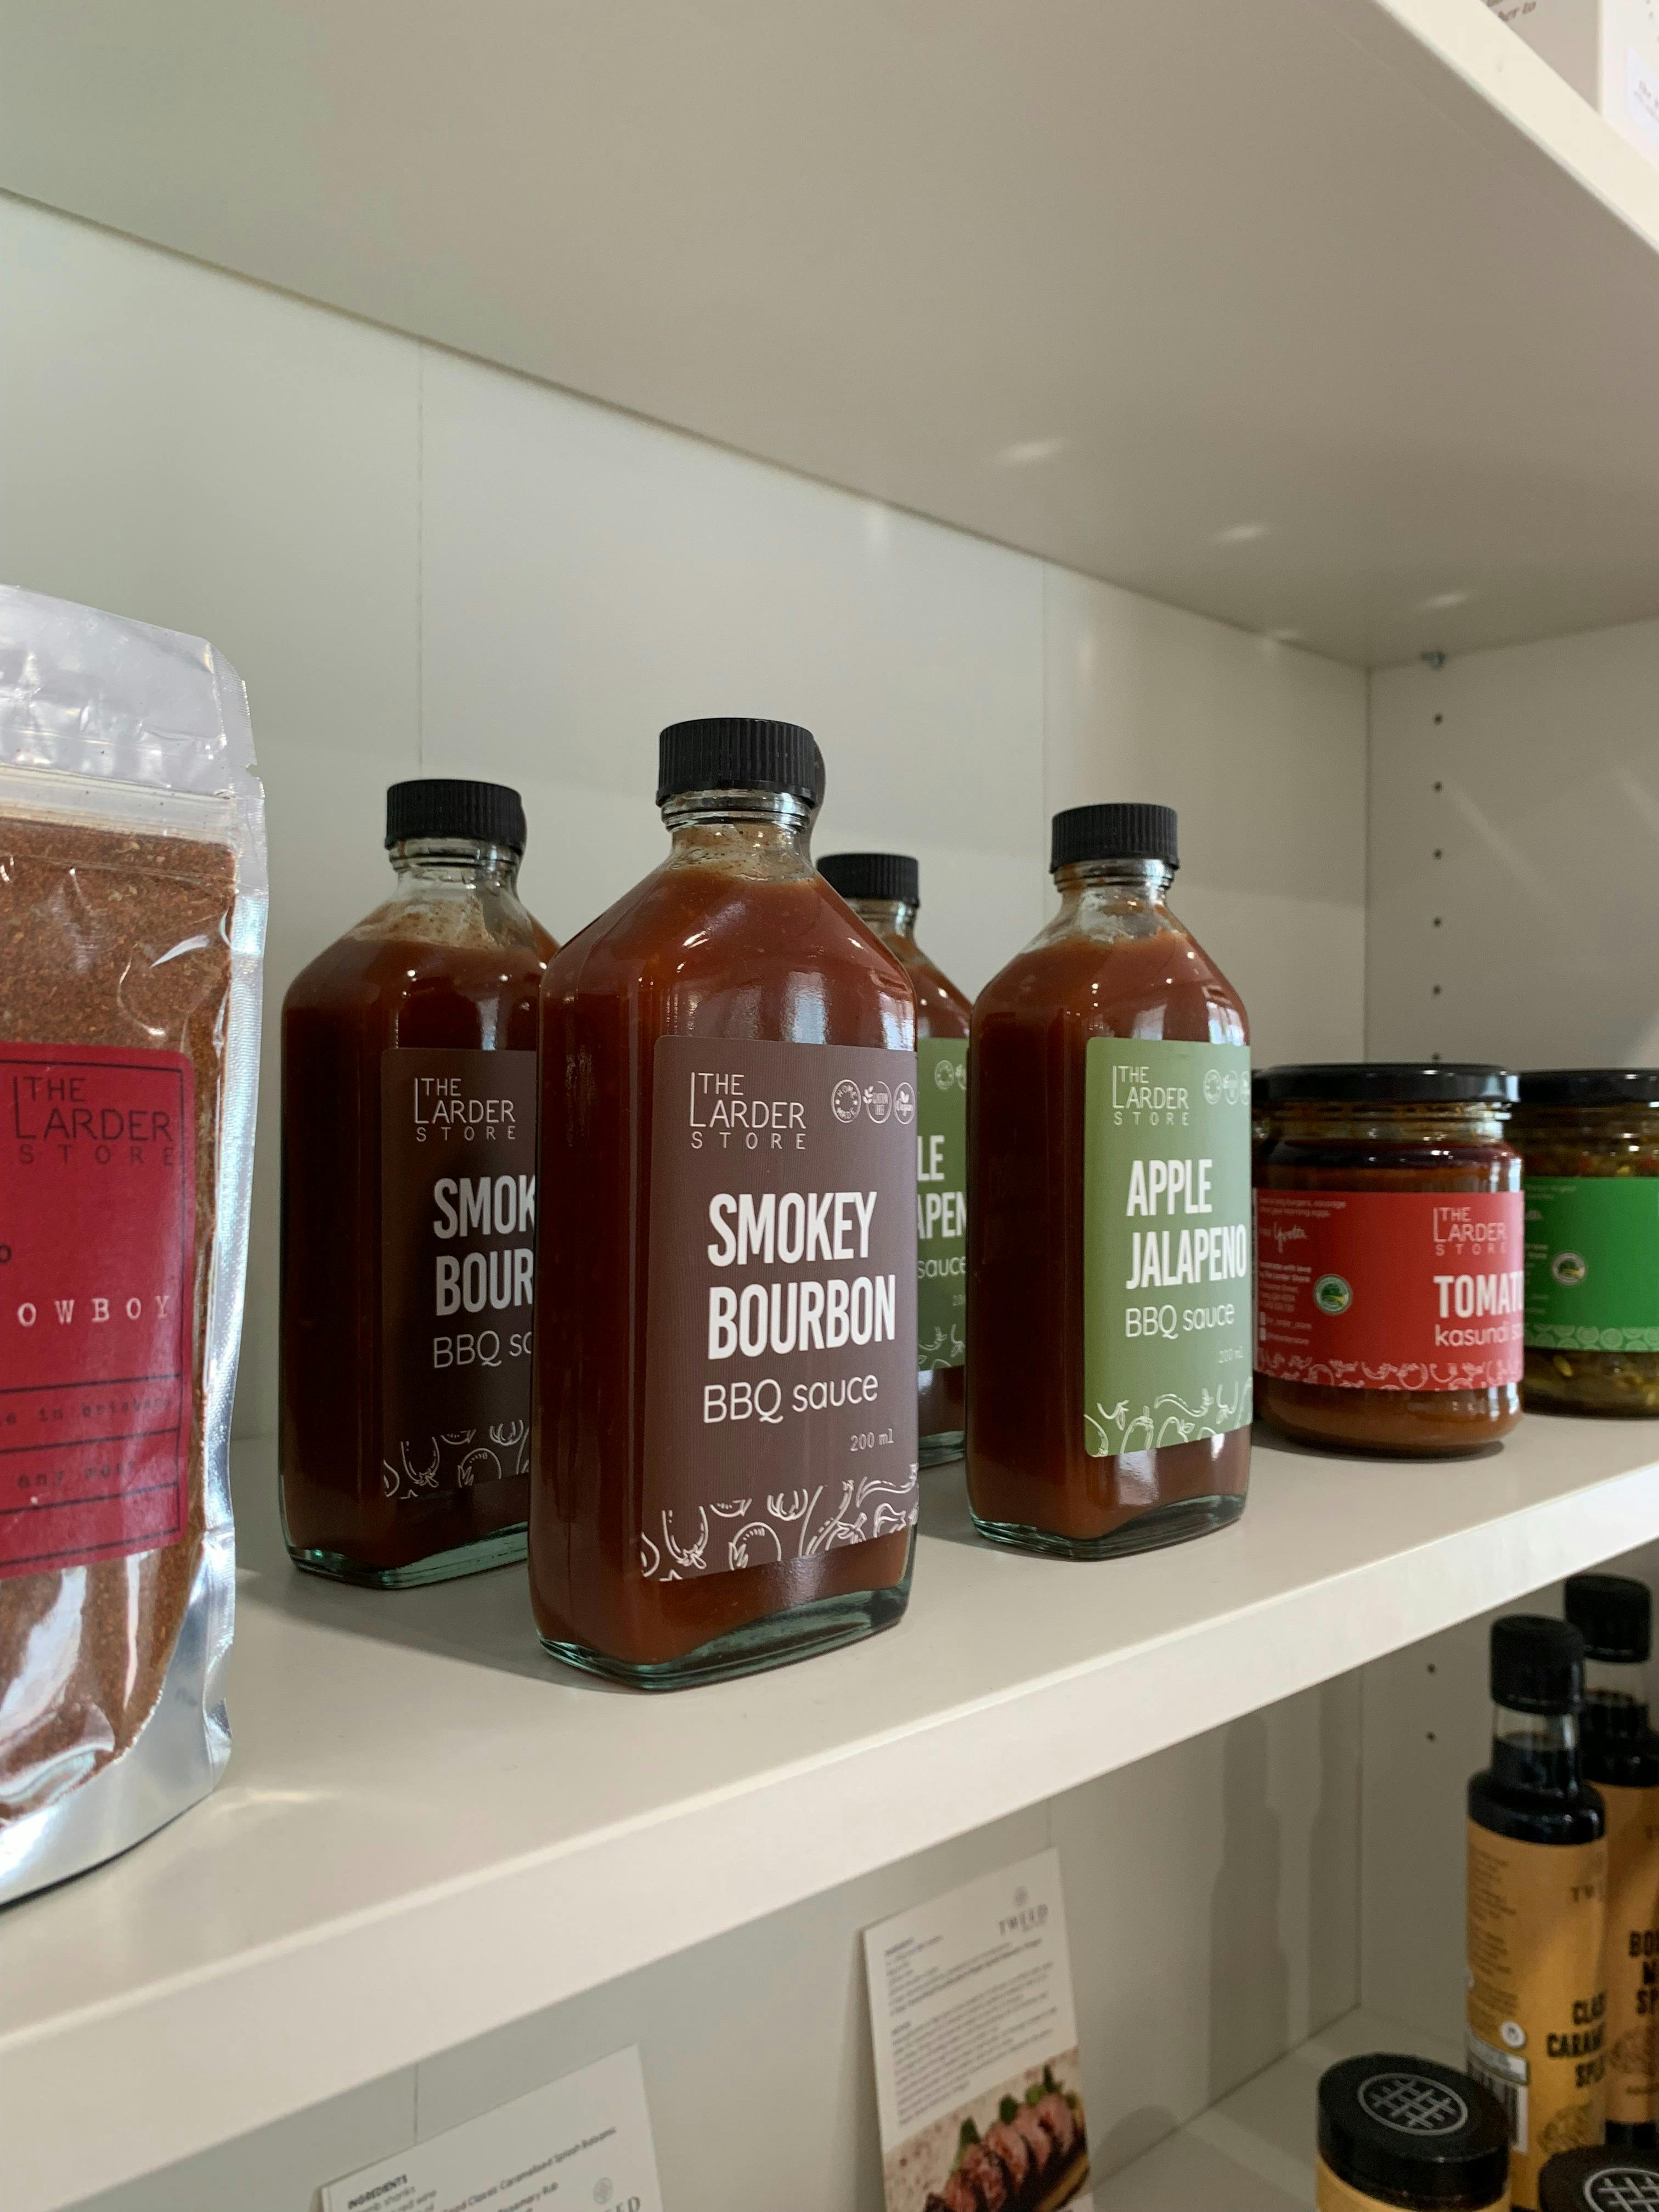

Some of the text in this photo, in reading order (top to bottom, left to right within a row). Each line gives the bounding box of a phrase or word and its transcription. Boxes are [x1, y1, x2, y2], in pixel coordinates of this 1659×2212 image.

[22, 1076, 87, 1102] THE
[421, 1077, 462, 1097] THE
[698, 1073, 744, 1096] THE
[1112, 1065, 1189, 1109] LARDER
[1118, 1065, 1149, 1084] THE
[13, 1076, 174, 1142] LARDER
[414, 1077, 516, 1124] LARDER
[690, 1071, 806, 1128] LARDER
[1113, 1111, 1189, 1126] STORE
[416, 1126, 516, 1142] STORE
[691, 1131, 806, 1149] STORE
[19, 1144, 174, 1166] STORE
[917, 1135, 945, 1181] LE
[1126, 1159, 1212, 1216] APPLE
[433, 1175, 535, 1239] SMOK
[1434, 1207, 1506, 1243] LARDER
[1440, 1207, 1471, 1222] THE
[708, 1192, 877, 1267] SMOKEY
[1126, 1224, 1247, 1290] JALAPENO
[436, 1248, 534, 1316] BOUR
[708, 1274, 895, 1360] BOURBON
[1125, 1305, 1179, 1340] BBQ
[1183, 1304, 1235, 1331] sauce
[433, 1330, 502, 1368] BBQ
[703, 1375, 879, 1424] BBQ sauce
[850, 1428, 894, 1452] 200 ml
